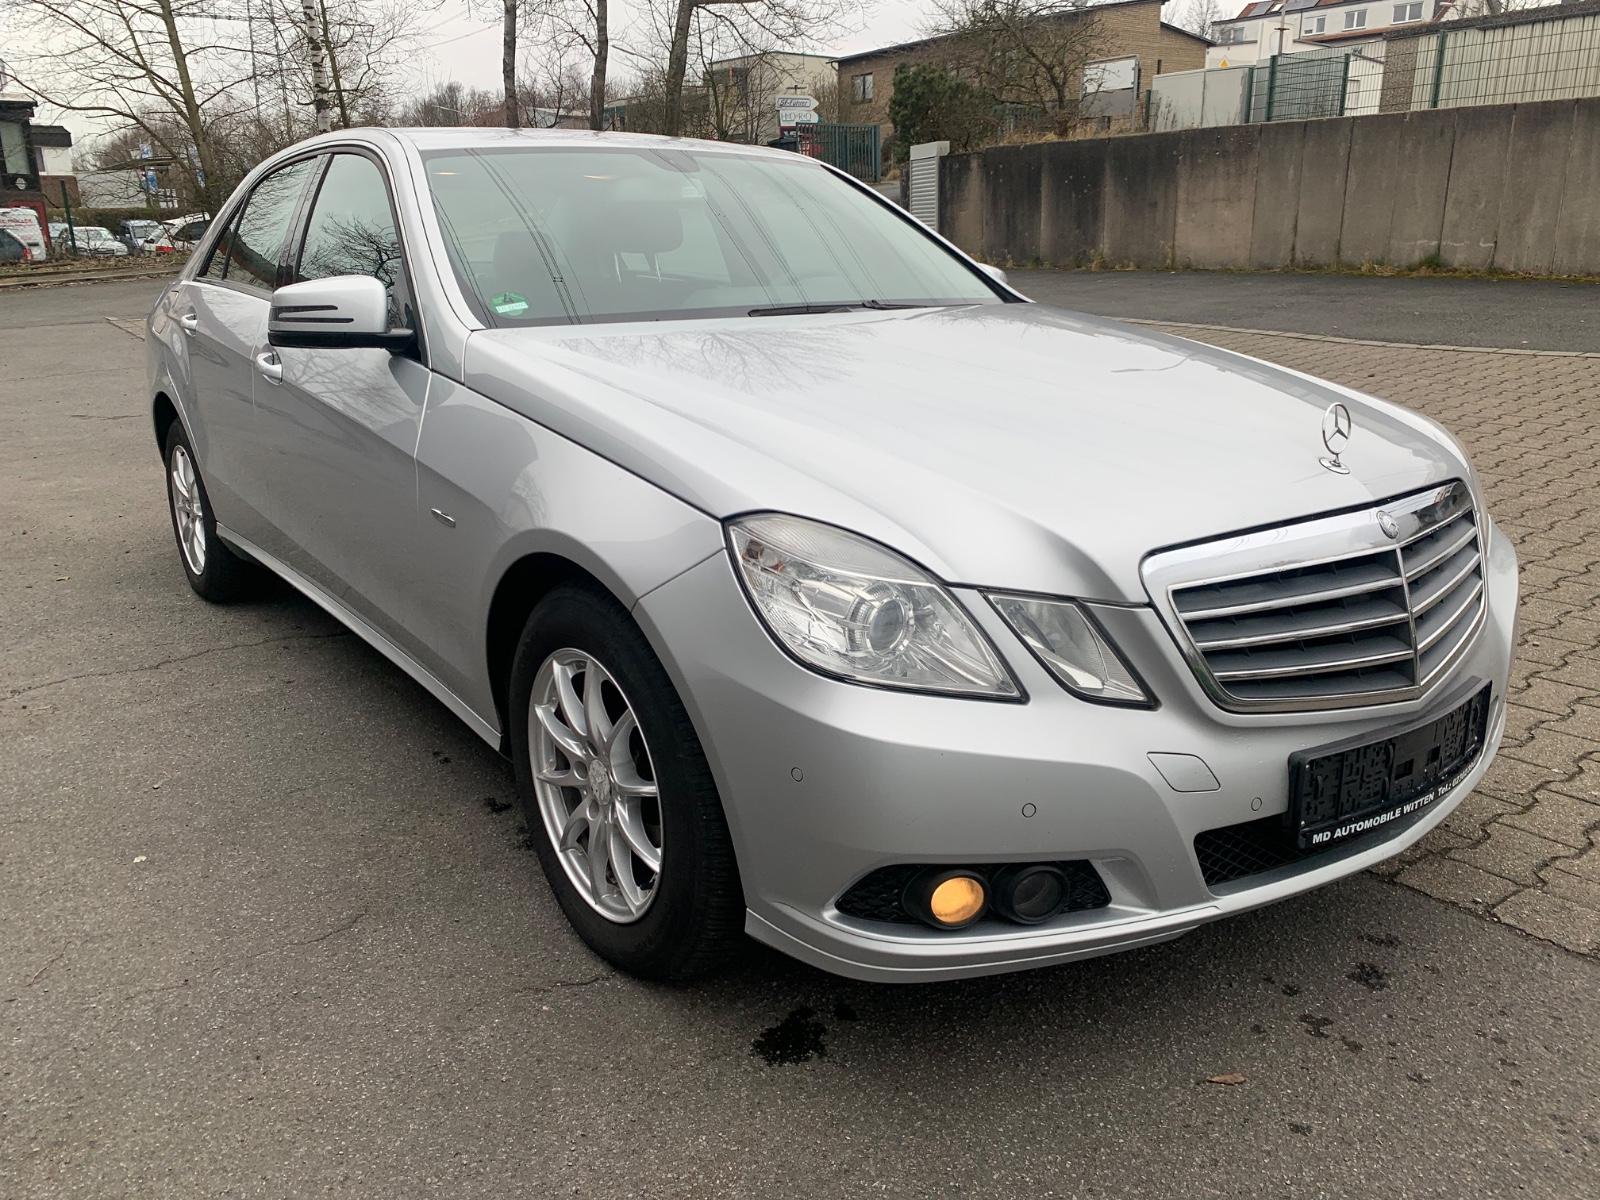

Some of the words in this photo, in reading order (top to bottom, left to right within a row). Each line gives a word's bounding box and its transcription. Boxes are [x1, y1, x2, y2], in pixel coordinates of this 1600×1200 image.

[1312, 831, 1331, 844] MD
[1333, 807, 1402, 838] AUTOMOBILE
[1403, 792, 1435, 814] WITTEN
